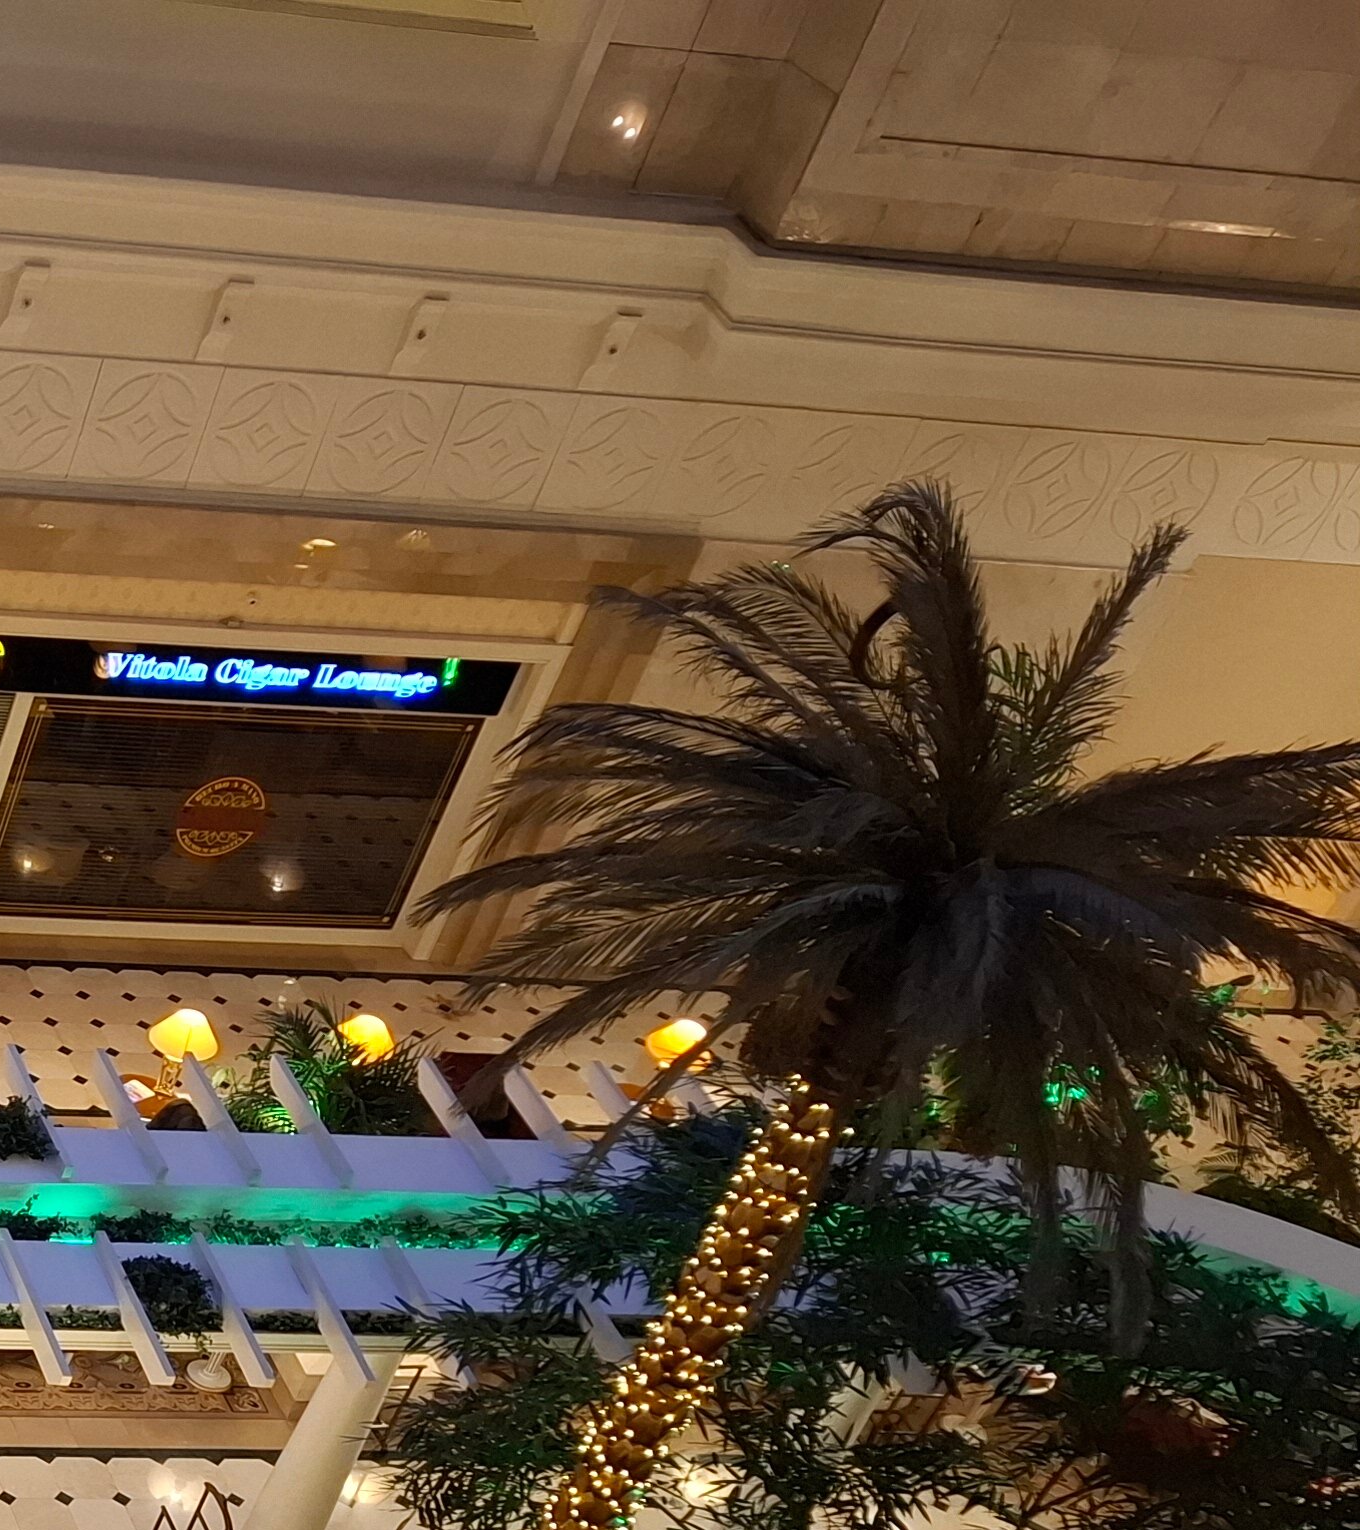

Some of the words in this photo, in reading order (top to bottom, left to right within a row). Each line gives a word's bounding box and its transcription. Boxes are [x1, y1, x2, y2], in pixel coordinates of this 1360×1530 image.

[107, 652, 209, 682] Vitola
[214, 657, 310, 690] Cigar
[311, 663, 438, 698] Lounge
